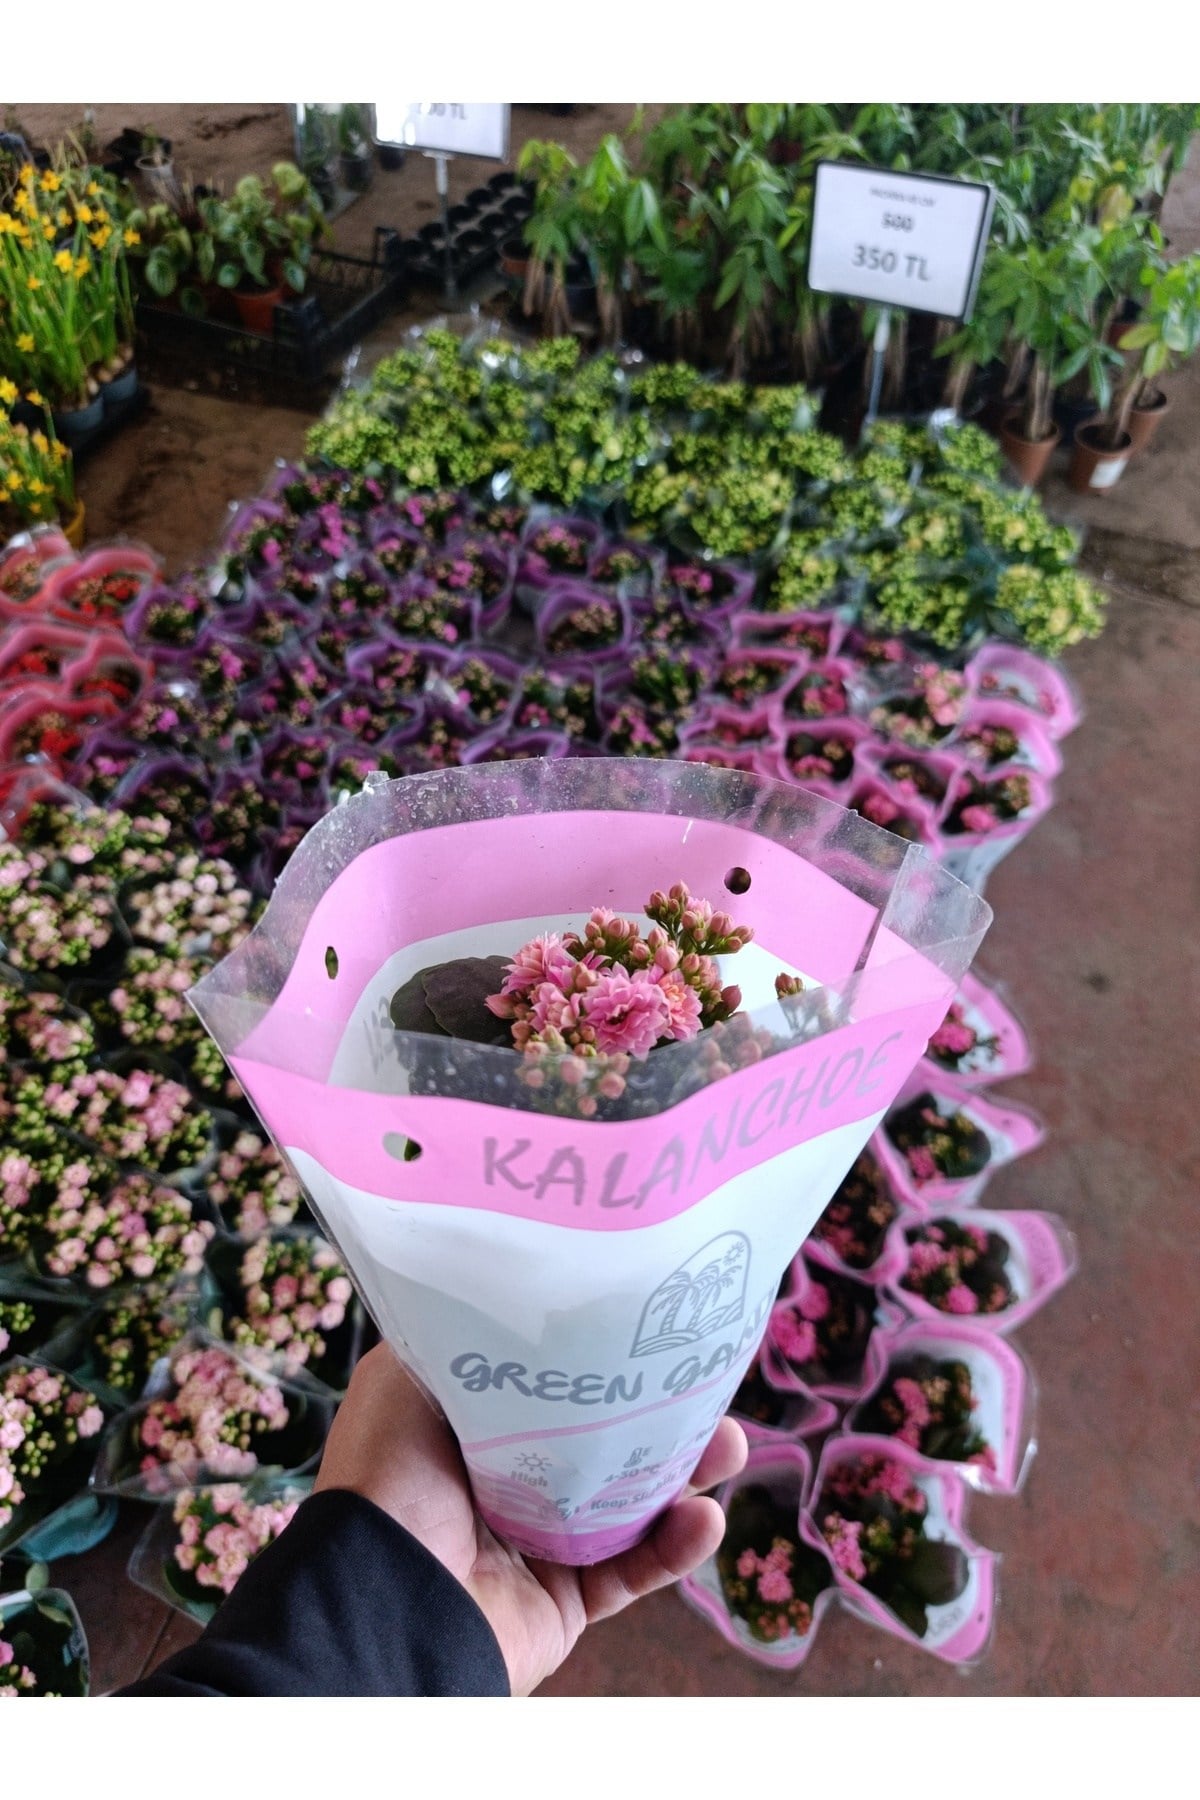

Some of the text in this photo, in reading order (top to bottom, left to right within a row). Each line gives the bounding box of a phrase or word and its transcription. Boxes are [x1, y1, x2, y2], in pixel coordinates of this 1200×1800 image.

[852, 245, 931, 281] 350 TL
[482, 1030, 904, 1211] KALANCHOE
[450, 1352, 644, 1405] GREEN
[510, 1470, 549, 1488] High
[590, 1498, 629, 1511] Keep
